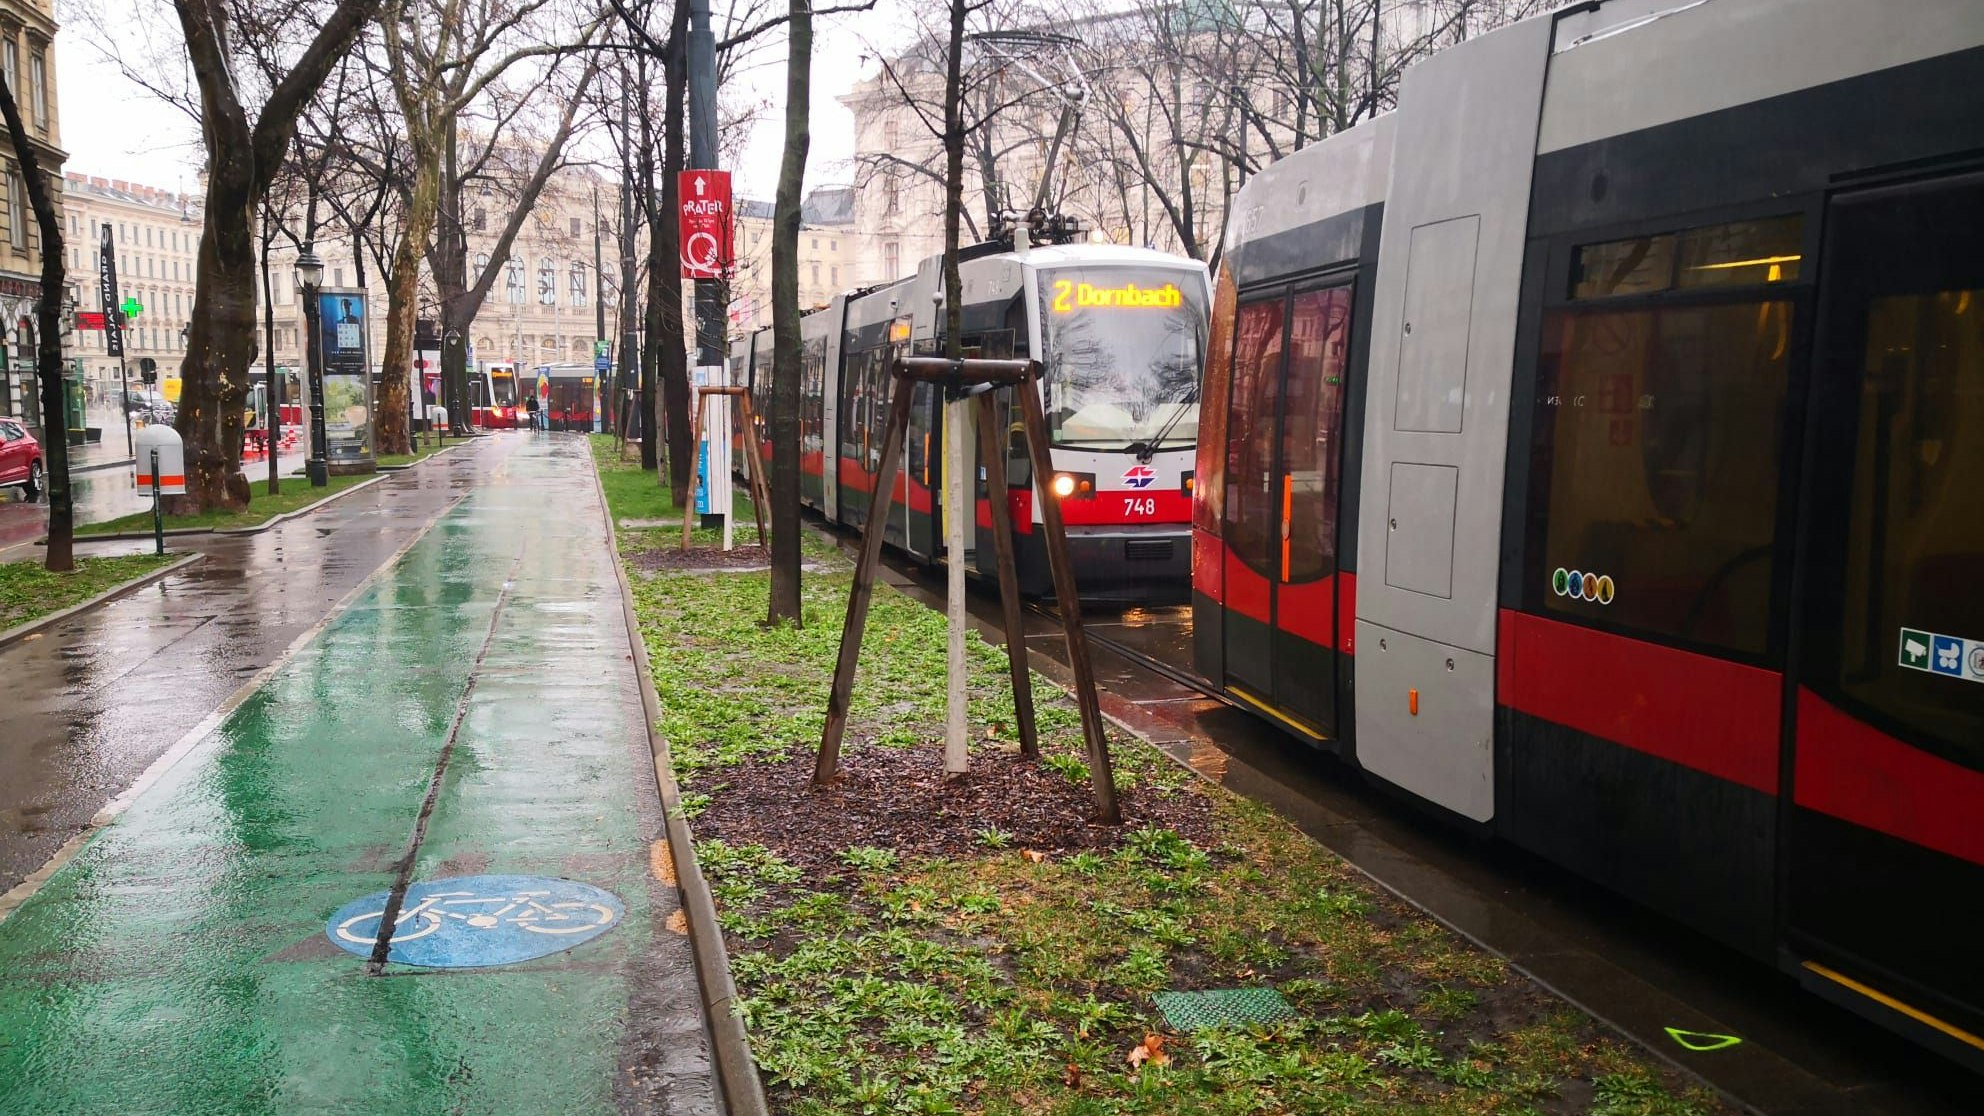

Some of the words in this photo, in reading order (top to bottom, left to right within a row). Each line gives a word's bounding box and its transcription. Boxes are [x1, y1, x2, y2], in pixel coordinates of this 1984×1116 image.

[683, 200, 723, 216] PRATER
[1053, 280, 1072, 311] 2
[1076, 282, 1181, 308] Dornbach
[1123, 498, 1155, 516] 748
